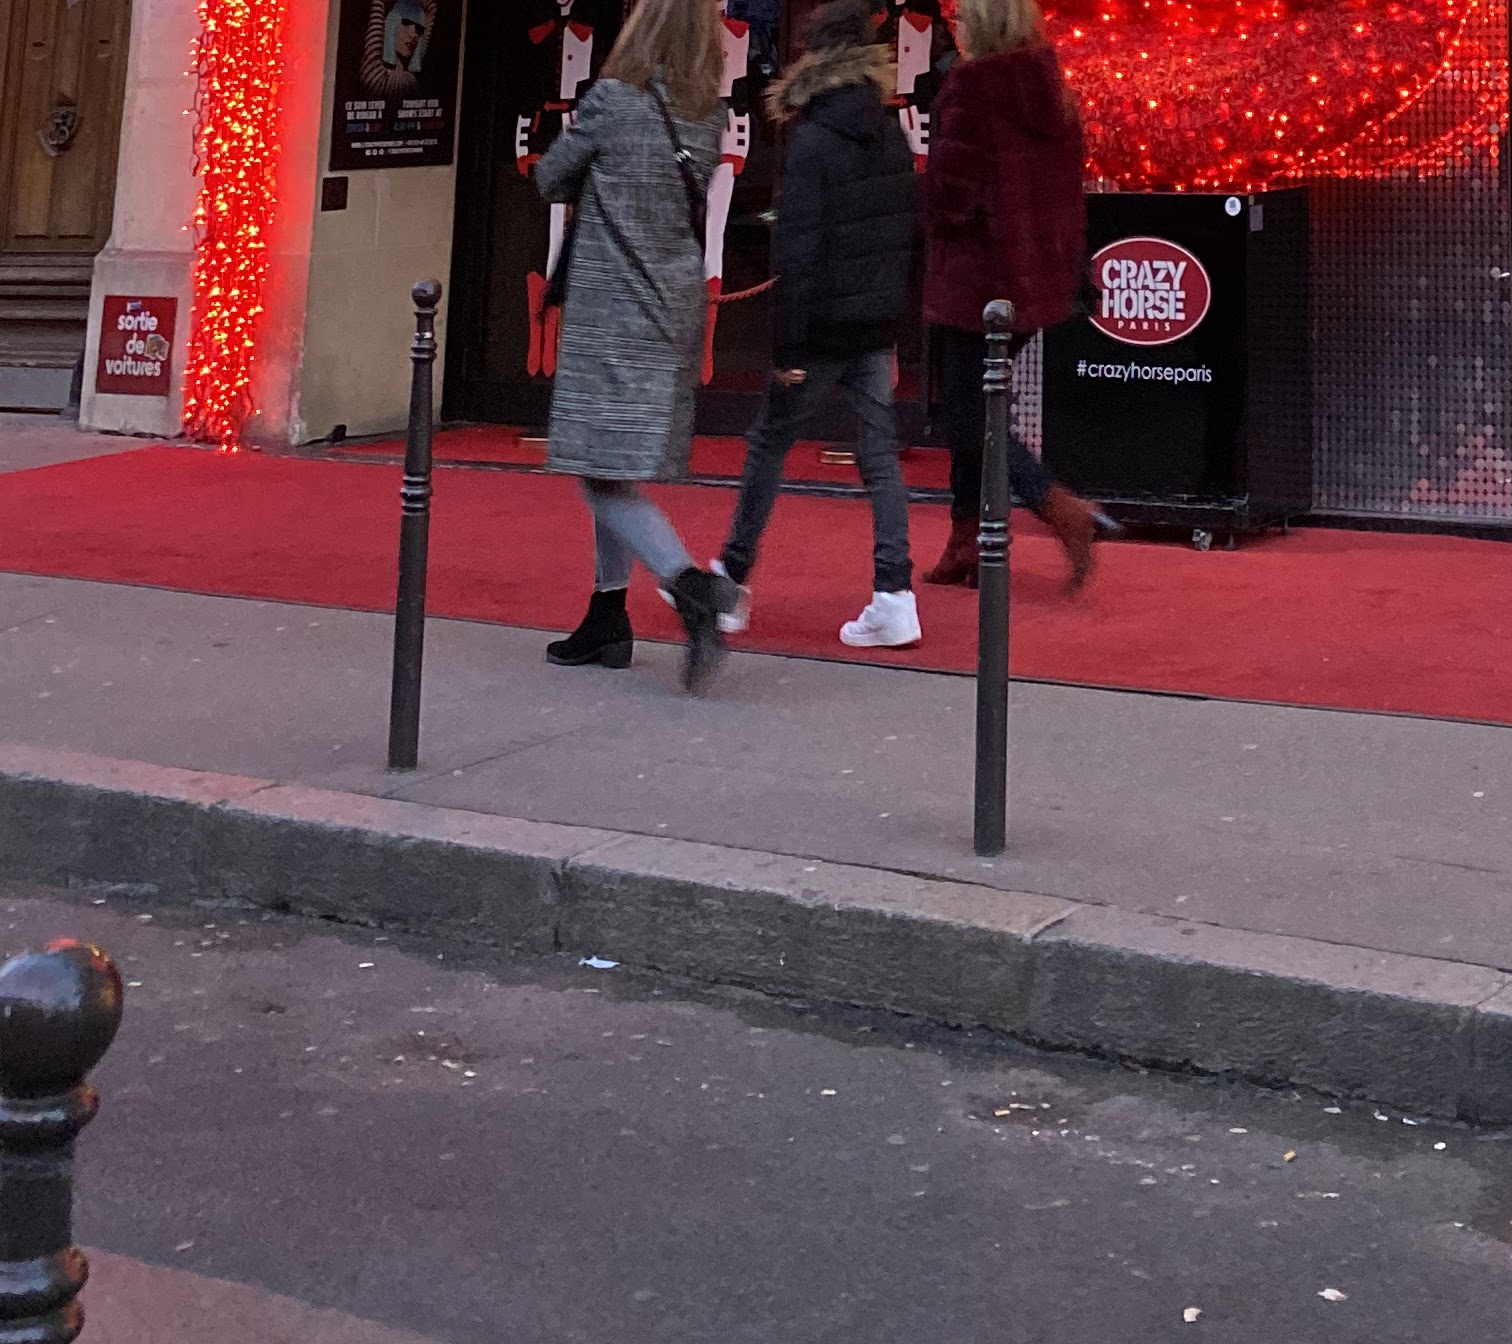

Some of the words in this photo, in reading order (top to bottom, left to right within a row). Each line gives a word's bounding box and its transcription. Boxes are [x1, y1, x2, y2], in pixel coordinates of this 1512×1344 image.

[1101, 259, 1187, 290] CRAZY
[1101, 288, 1186, 321] HORSE
[117, 311, 158, 331] sortie
[1117, 320, 1171, 332] PARIS
[125, 332, 145, 355] de
[105, 354, 161, 377] voitures
[1076, 359, 1213, 385] #crazyhorseparis
